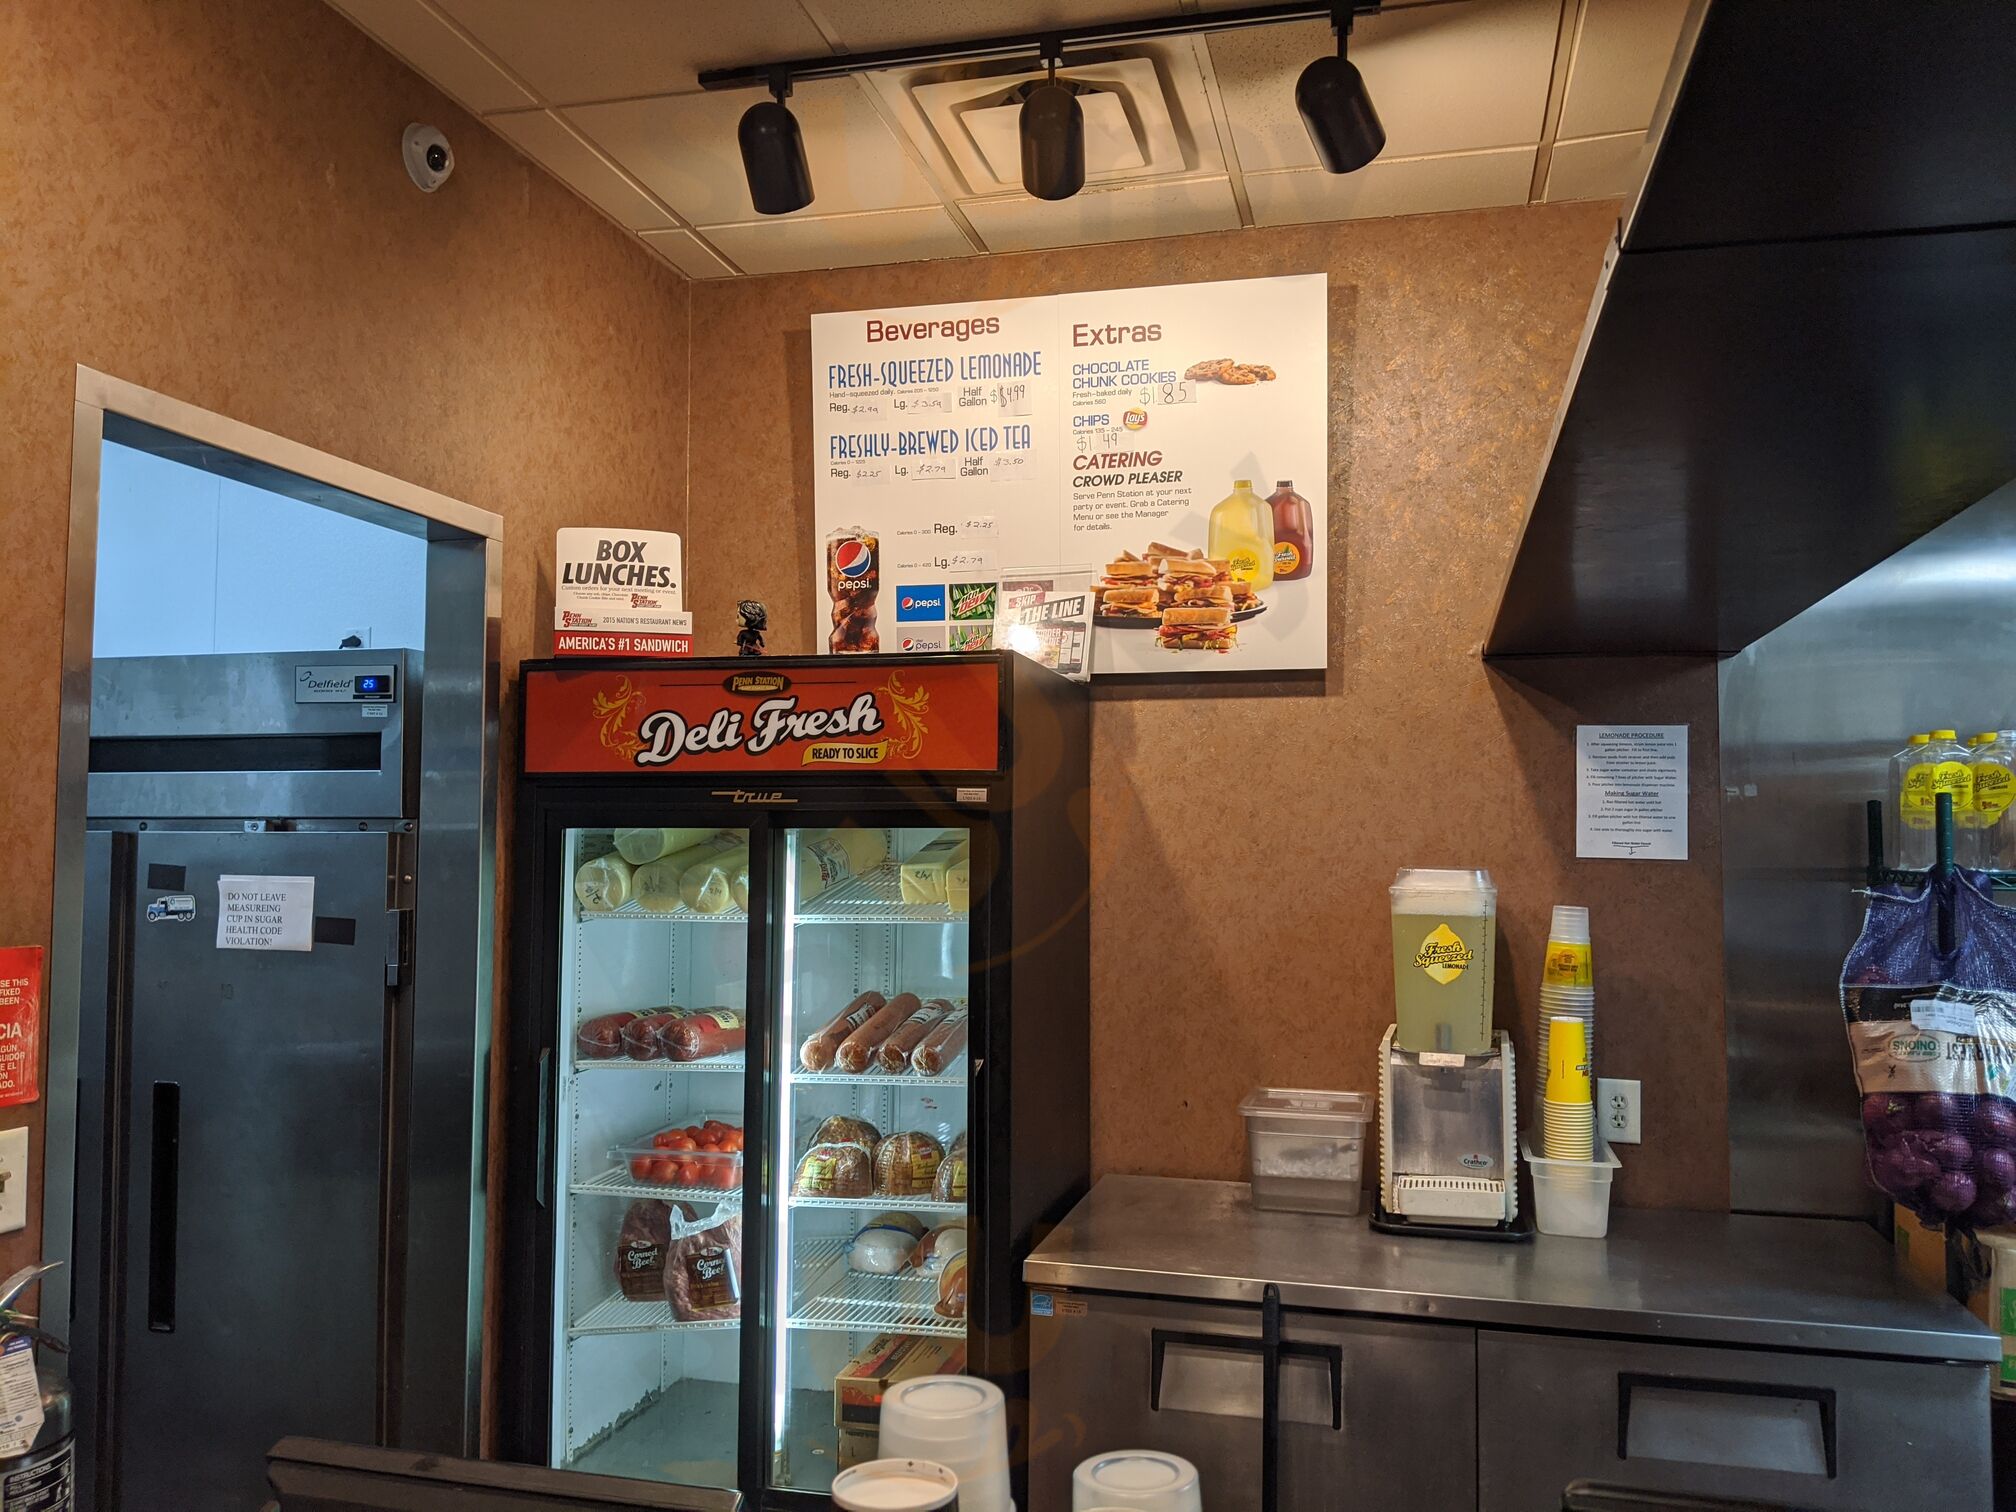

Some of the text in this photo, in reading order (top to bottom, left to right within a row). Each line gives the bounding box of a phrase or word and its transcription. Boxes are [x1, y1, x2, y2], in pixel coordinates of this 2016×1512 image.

[866, 316, 1000, 343] Beverages
[1072, 324, 1162, 347] Extras
[828, 351, 1042, 390] FRESH-SQUEEZED LEMONADE
[1072, 359, 1150, 376] CHOCOLATE
[1072, 371, 1176, 390] CHUNK COOKIES
[829, 390, 878, 398] Hand-squeezed
[963, 386, 982, 396] Half
[1072, 388, 1132, 398] Fresh-baked daily
[894, 399, 908, 410] Lg.
[958, 396, 988, 407] Gallon
[829, 403, 850, 414] Reg.
[1072, 414, 1110, 428] CHIPS
[830, 424, 1031, 459] FRESHLY-BREWED ICED TEA
[964, 456, 984, 466] Half
[1072, 450, 1163, 470] CATERING
[830, 468, 852, 478] Reg.
[894, 465, 909, 476] Lg.
[960, 466, 989, 476] Gallon
[1072, 470, 1183, 488] CROWD PLEASER
[1072, 492, 1096, 500] Serve
[1096, 490, 1116, 498] Penn
[1116, 489, 1144, 498] Station
[1156, 488, 1173, 498] your
[1174, 487, 1192, 495] next
[1072, 502, 1094, 512] party
[1105, 501, 1128, 509] event.
[1130, 499, 1148, 508] Grab
[1156, 498, 1190, 508] Catering
[1072, 512, 1094, 522] Menu
[1120, 510, 1134, 518] the
[1134, 510, 1170, 519] Manager
[934, 523, 958, 536] Reg.
[1072, 522, 1112, 532] for details.
[596, 540, 648, 563] BOX
[934, 556, 950, 570] Lg.
[562, 562, 677, 588] LUNCHES.
[838, 578, 870, 592] pepsi
[914, 597, 942, 608] pepsi
[1016, 594, 1037, 608] SKIP
[562, 610, 582, 620] PENN
[1022, 598, 1082, 624] THE LINE
[563, 618, 592, 628] STATION
[602, 616, 616, 624] 2015
[616, 616, 640, 624] NATION'S
[640, 618, 671, 626] RESTAURANT
[558, 636, 689, 653] AMERICA'S #1 SANDWICH
[915, 640, 942, 652] pepsi
[308, 680, 351, 689] Delfield
[362, 680, 374, 689] 25
[732, 676, 784, 692] PENN STATION
[637, 694, 882, 764] Deli Fresh
[812, 747, 879, 760] READY TO SLICE
[228, 892, 287, 902] DO NOT LEAVE
[227, 904, 281, 912] MEASUREING
[226, 914, 282, 924] CUP IN SUGAR
[225, 926, 282, 935] HEALTH CODE
[225, 936, 273, 946] VIOLATION!
[1424, 941, 1463, 958] Fresh
[1413, 949, 1474, 968] Squeezed
[12, 978, 29, 986] THIS
[0, 988, 20, 996] FIXED
[0, 1022, 22, 1040] CIA
[1892, 1040, 1936, 1050] ONIONS
[8, 1062, 16, 1070] EL
[628, 1248, 658, 1262] Corned
[632, 1258, 652, 1270] Beef
[696, 1258, 724, 1272] Corne
